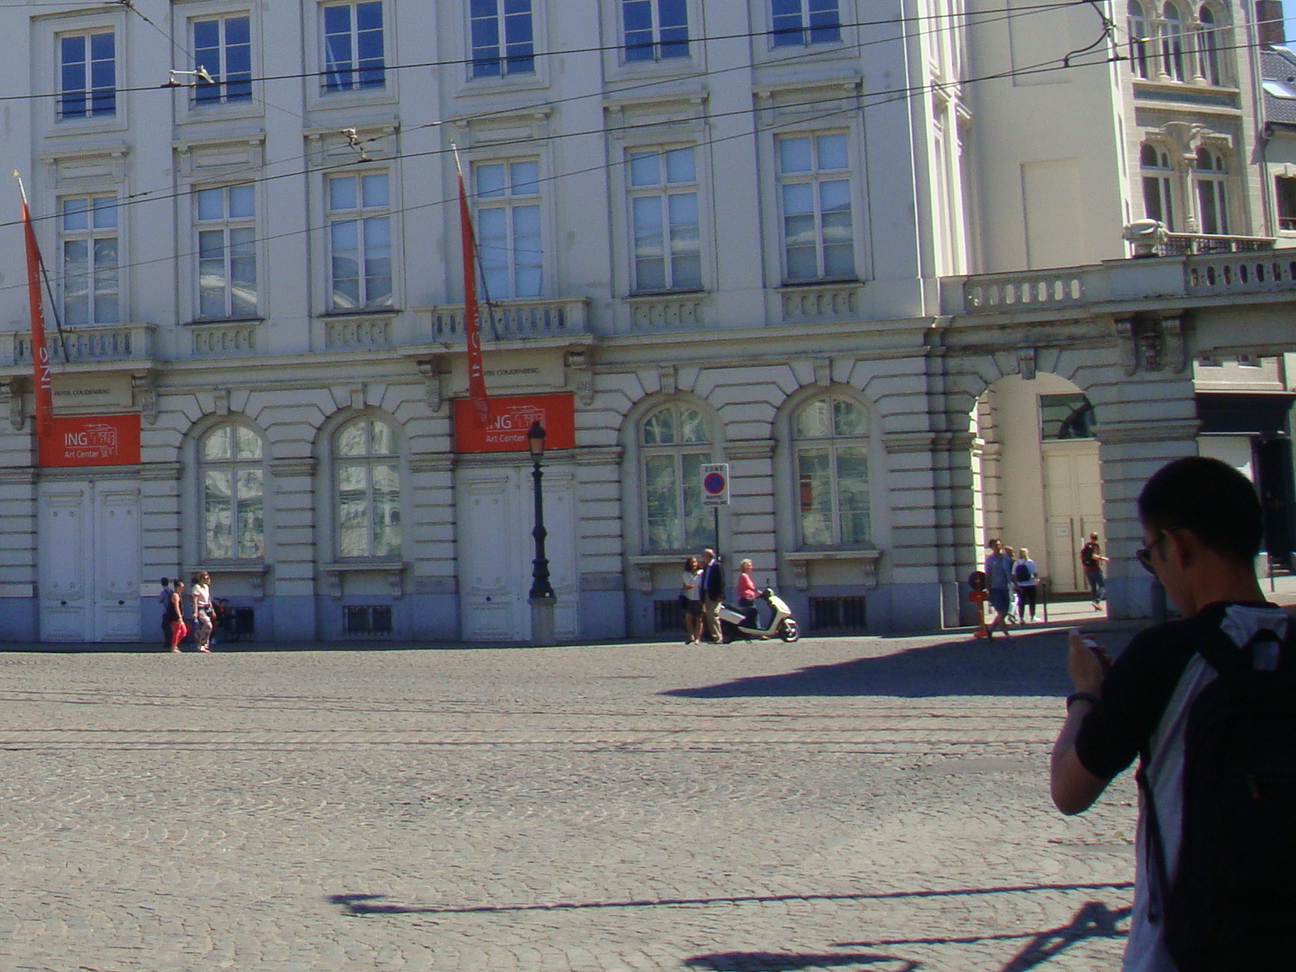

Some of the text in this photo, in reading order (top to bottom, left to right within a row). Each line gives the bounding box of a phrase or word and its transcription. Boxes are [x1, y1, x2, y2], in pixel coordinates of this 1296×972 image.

[64, 432, 88, 446] ING
[485, 433, 526, 443] Art Center
[64, 449, 100, 459] Art Center
